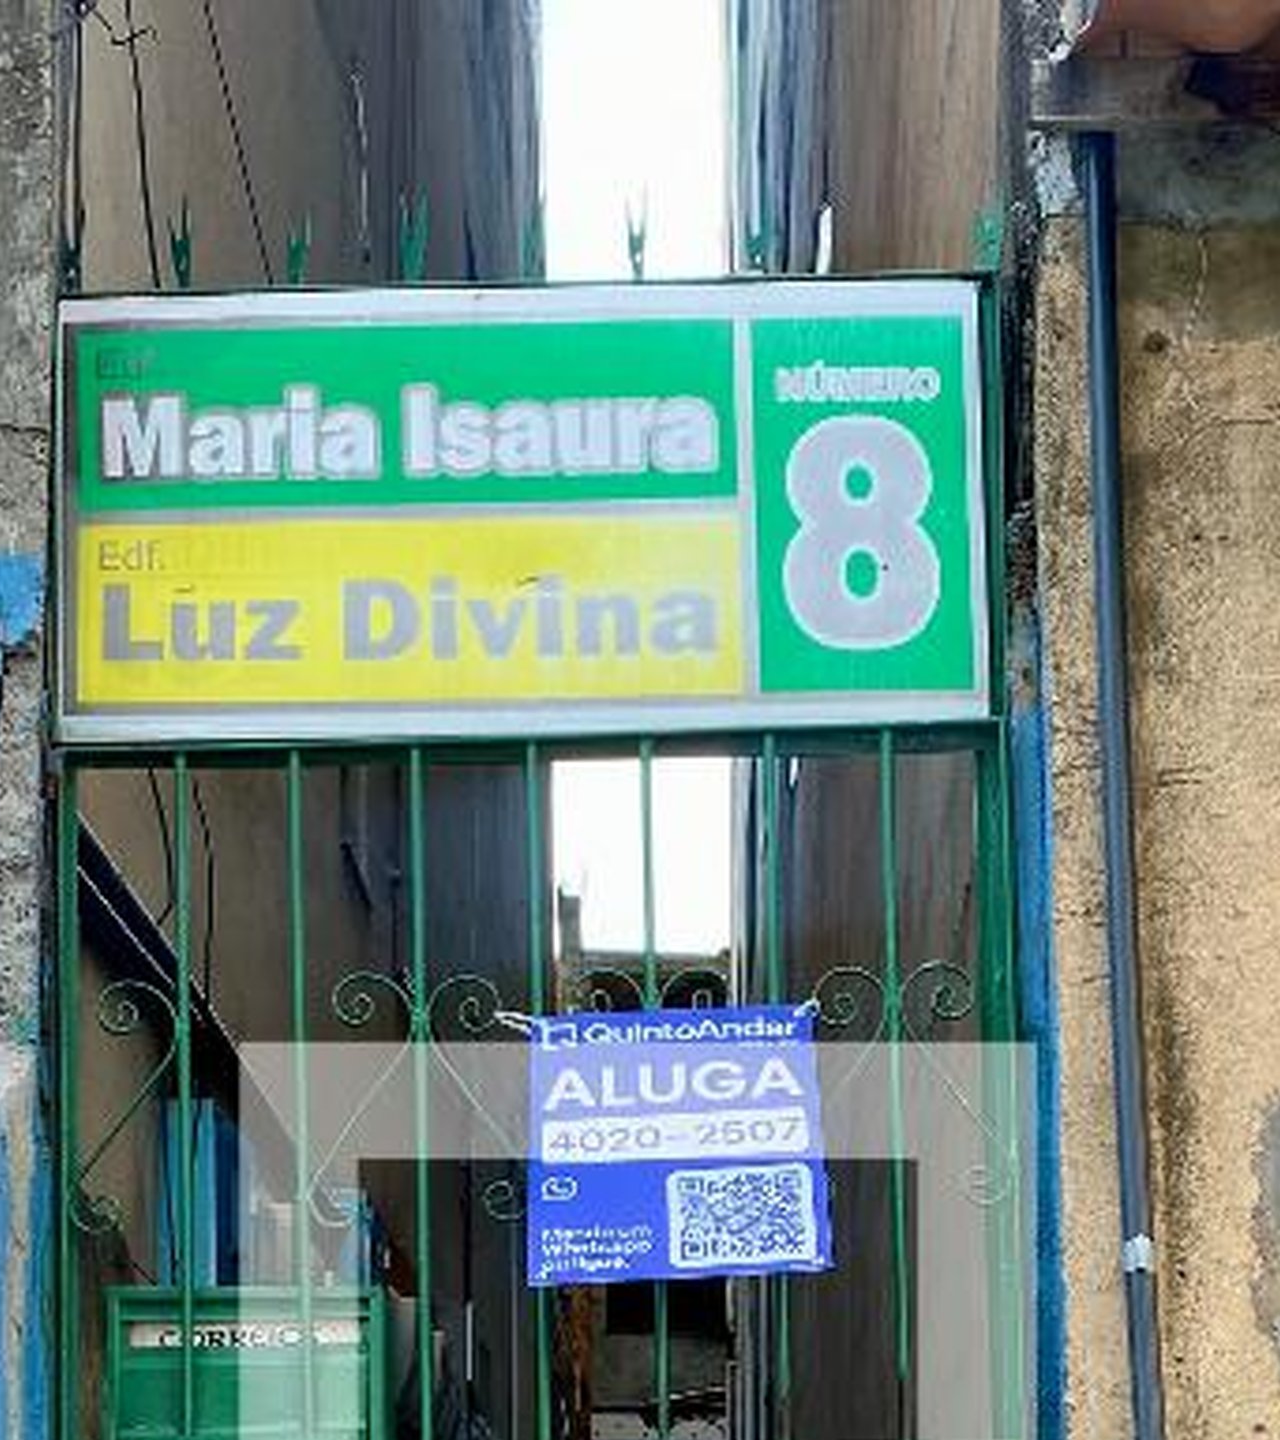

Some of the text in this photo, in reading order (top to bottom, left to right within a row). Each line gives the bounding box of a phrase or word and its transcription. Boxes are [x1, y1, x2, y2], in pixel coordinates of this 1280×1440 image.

[776, 360, 940, 401] NÚMERO
[102, 382, 719, 481] Maria Isaura
[99, 540, 164, 571] Edf.
[783, 414, 941, 650] 8
[102, 573, 718, 661] Luz Divina
[583, 1016, 798, 1045] QuintoAndar
[543, 1057, 806, 1112] ALUGA
[549, 1117, 803, 1154] 4020-2507
